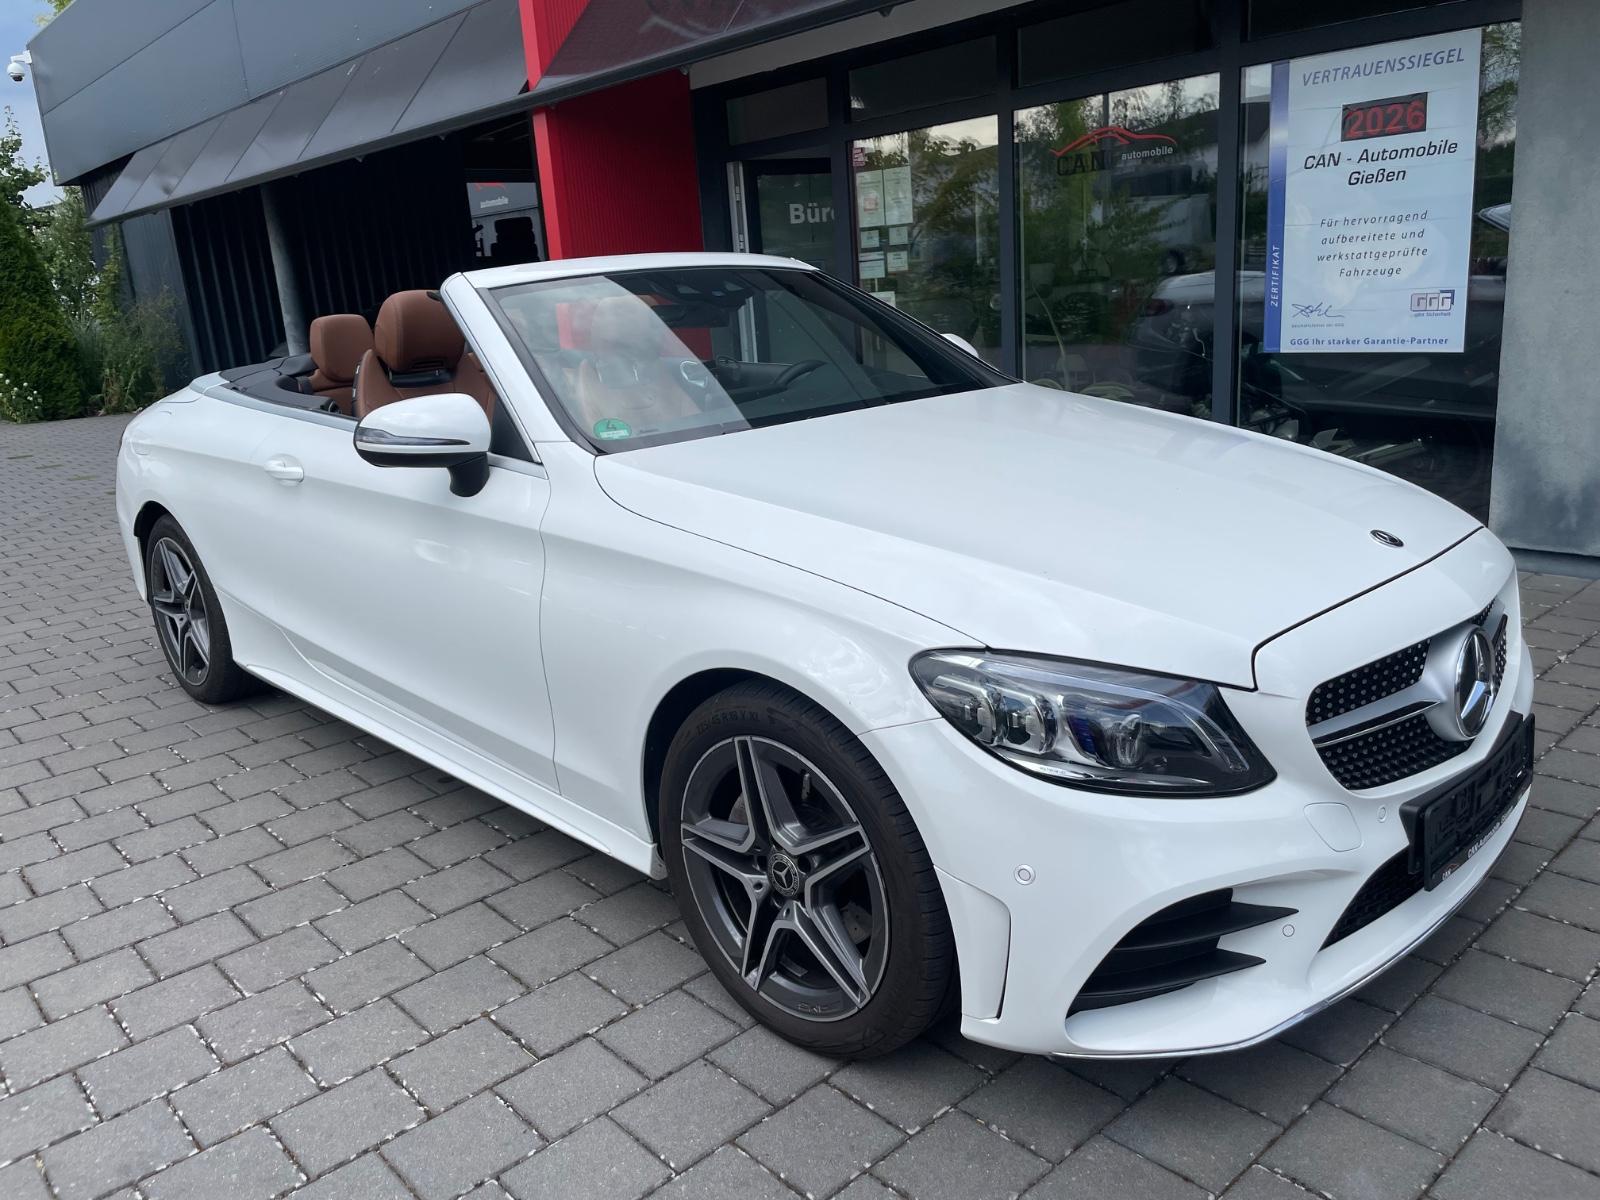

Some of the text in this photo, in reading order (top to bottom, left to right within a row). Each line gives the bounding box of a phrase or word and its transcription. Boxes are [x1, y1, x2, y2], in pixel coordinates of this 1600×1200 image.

[1303, 47, 1464, 86] VERTRAUENSSIEGEL
[1344, 100, 1425, 139] 2026
[1121, 145, 1174, 161] automobile
[1304, 152, 1341, 170] CAN
[1357, 140, 1458, 164] Automobile
[1056, 150, 1106, 176] CAN
[1348, 168, 1407, 186] Gießen
[1320, 210, 1428, 228] Für hervorragend
[1321, 229, 1425, 245] aufbereitete und
[1317, 247, 1428, 262] werkstattgeprüfte
[1270, 244, 1280, 308] ZERTIFIKAT
[1340, 267, 1402, 278] Fahrzeuge
[1290, 338, 1310, 346] GGG
[1327, 337, 1361, 346] starker
[1363, 336, 1449, 346] Garantie-Partner
